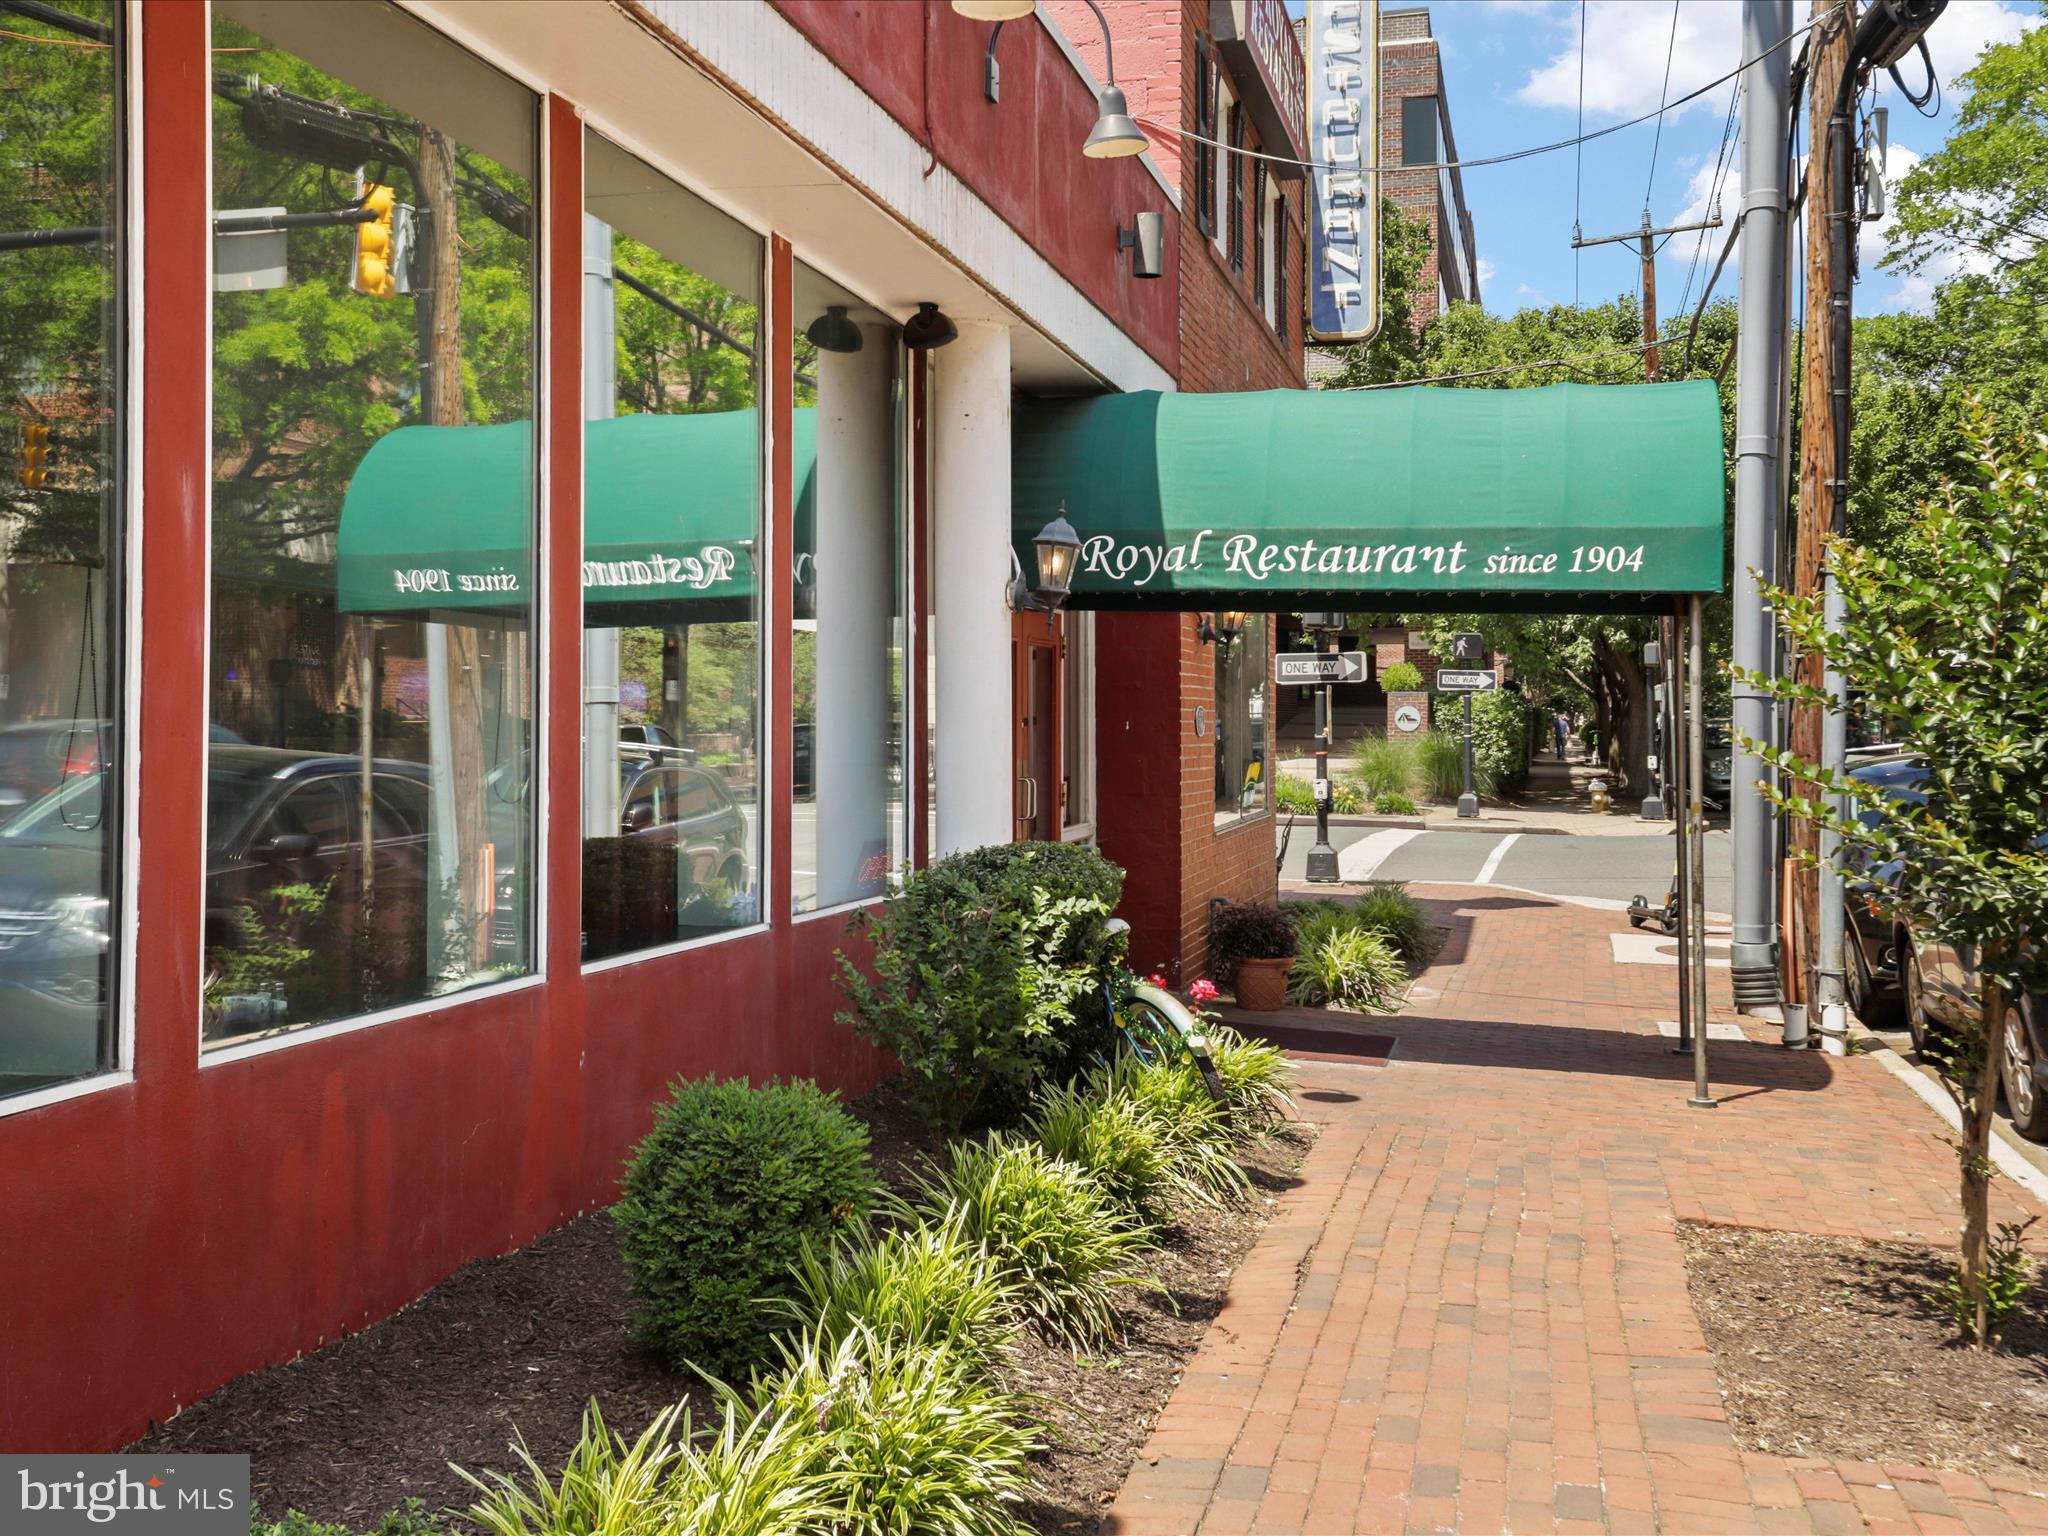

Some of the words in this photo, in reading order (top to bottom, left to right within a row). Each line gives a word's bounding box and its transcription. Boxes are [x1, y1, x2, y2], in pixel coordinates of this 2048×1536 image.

[1082, 529, 1213, 586] Royal
[1222, 534, 1467, 580] Restaurant
[1483, 546, 1558, 574] since
[1568, 545, 1644, 573] 1904
[1285, 663, 1308, 674] ONE
[1312, 662, 1336, 673] WAY
[1444, 676, 1460, 684] ONE
[1462, 676, 1479, 684] WAY
